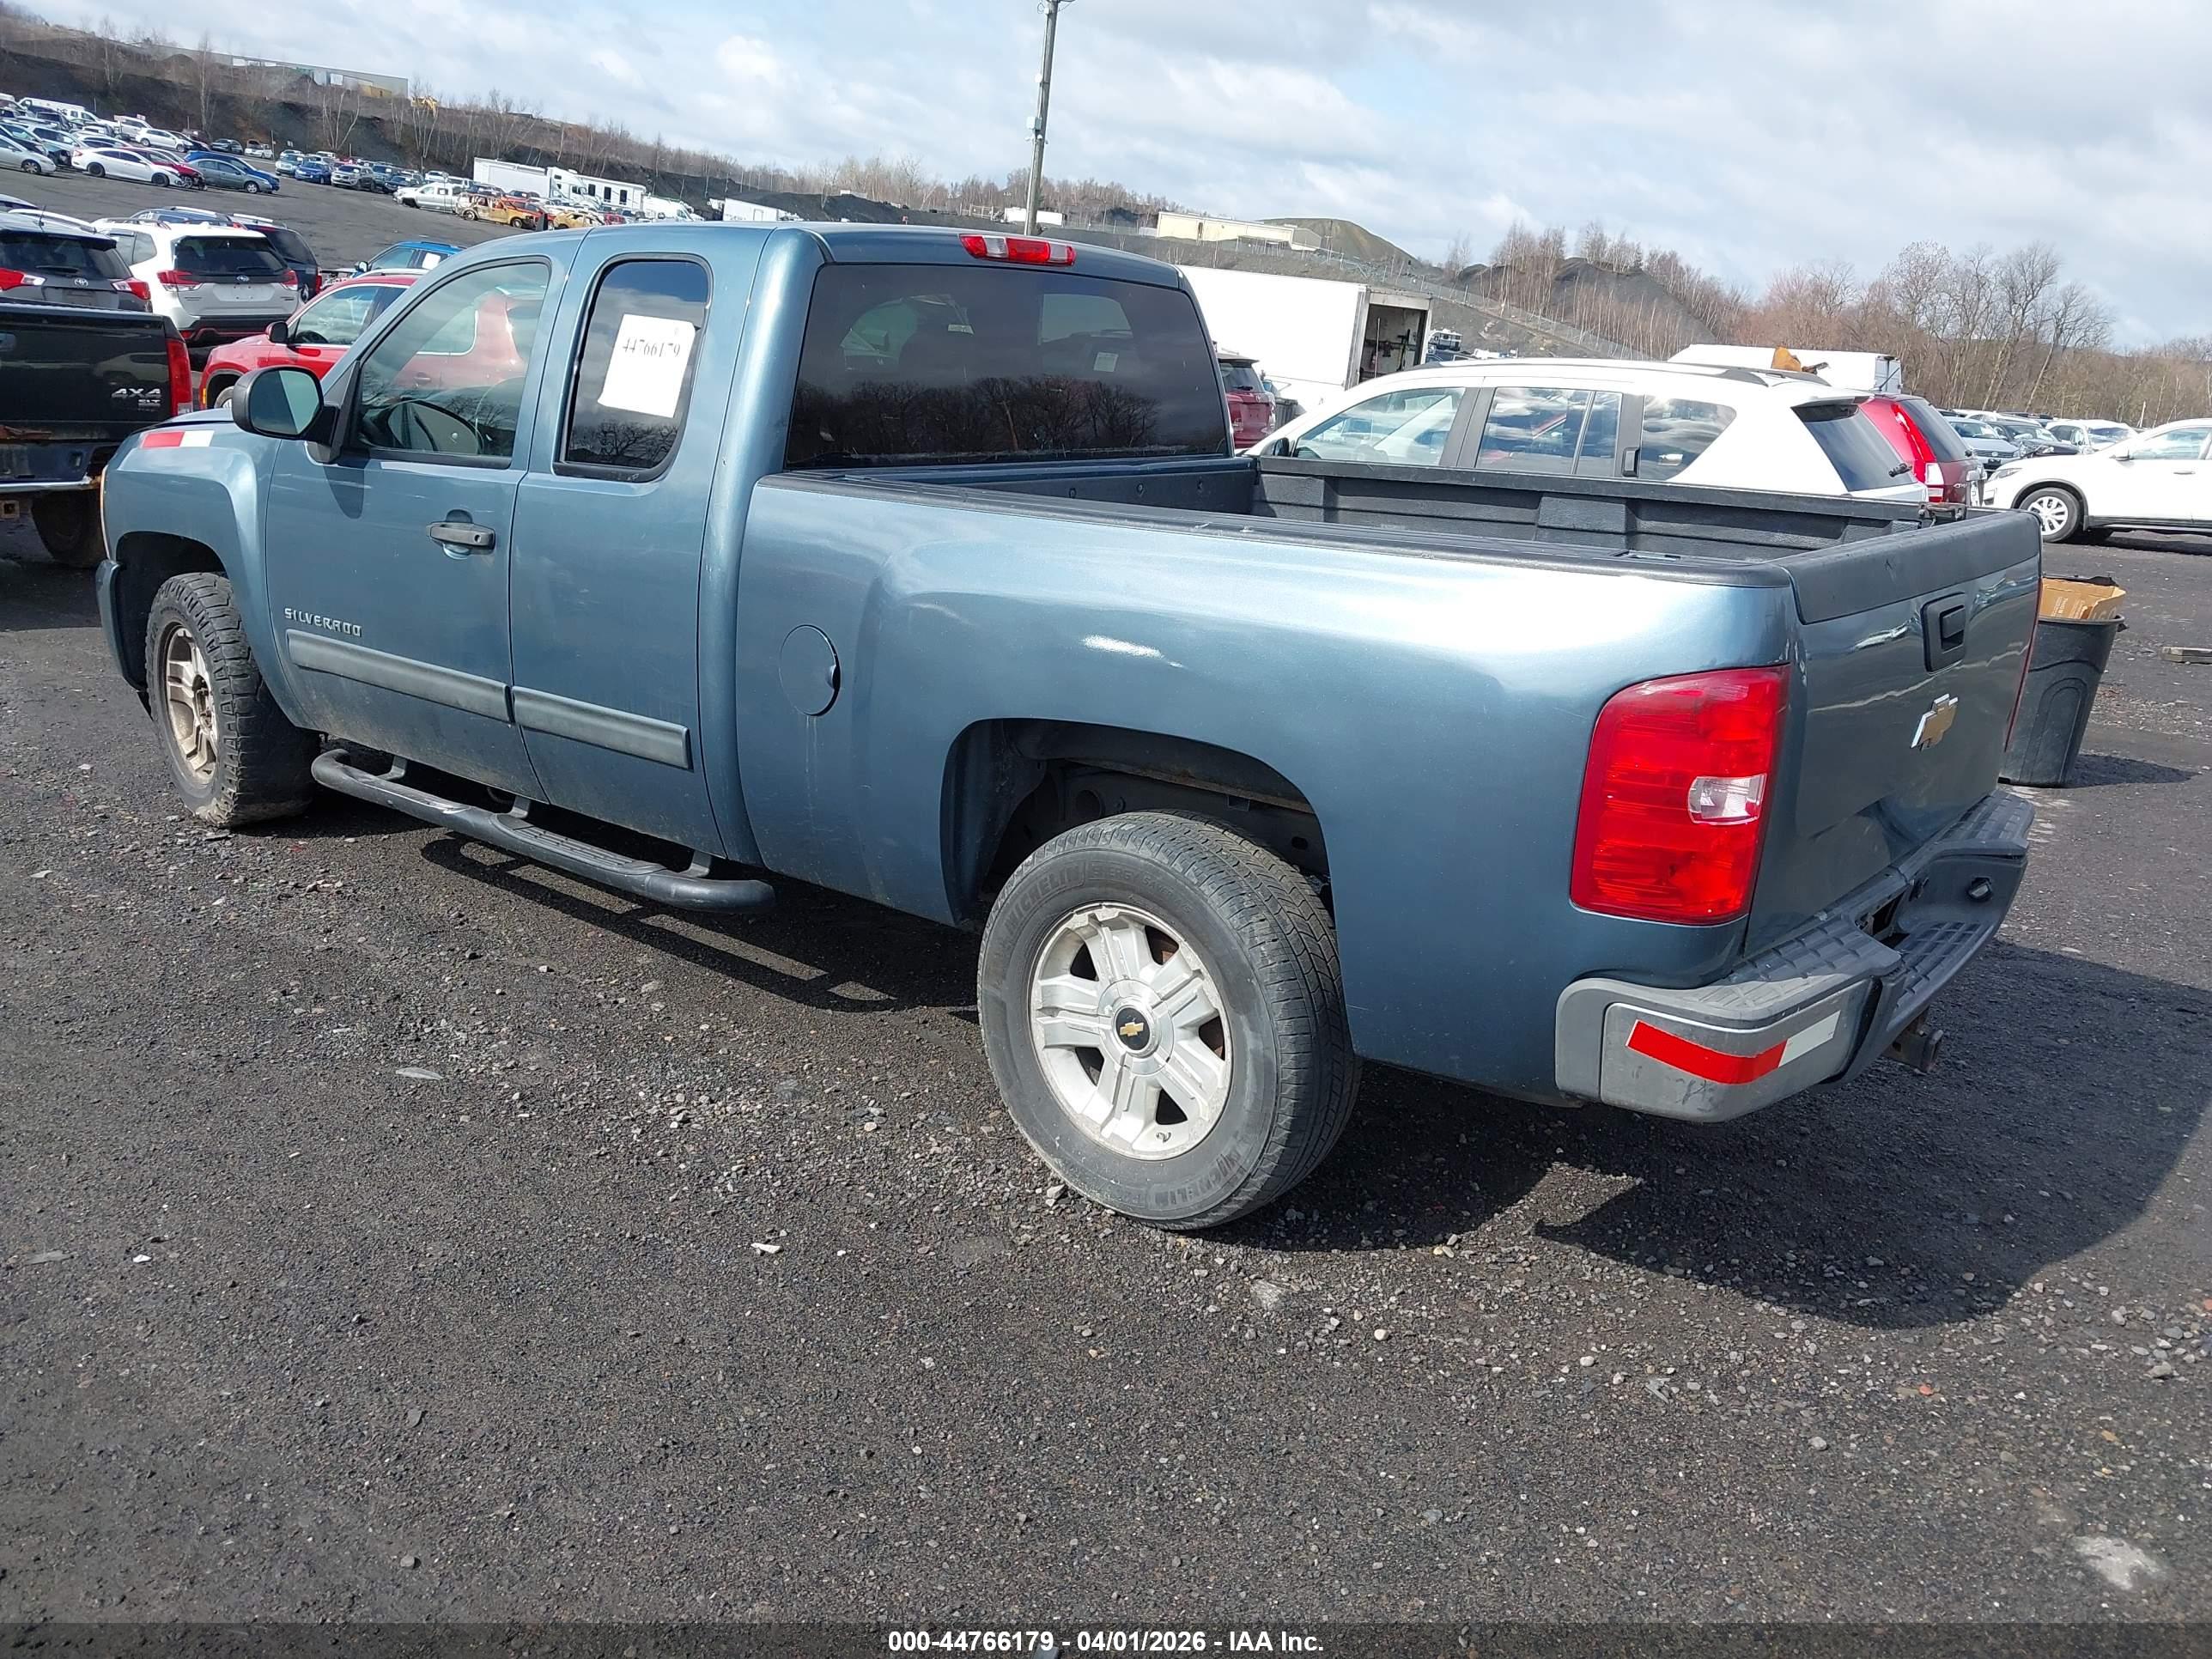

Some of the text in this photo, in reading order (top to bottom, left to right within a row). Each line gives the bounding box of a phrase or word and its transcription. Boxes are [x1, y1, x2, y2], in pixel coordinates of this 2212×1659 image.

[622, 336, 681, 358] 44766179
[284, 607, 362, 637] SILVERADO
[1004, 861, 1083, 936] MICHELIN
